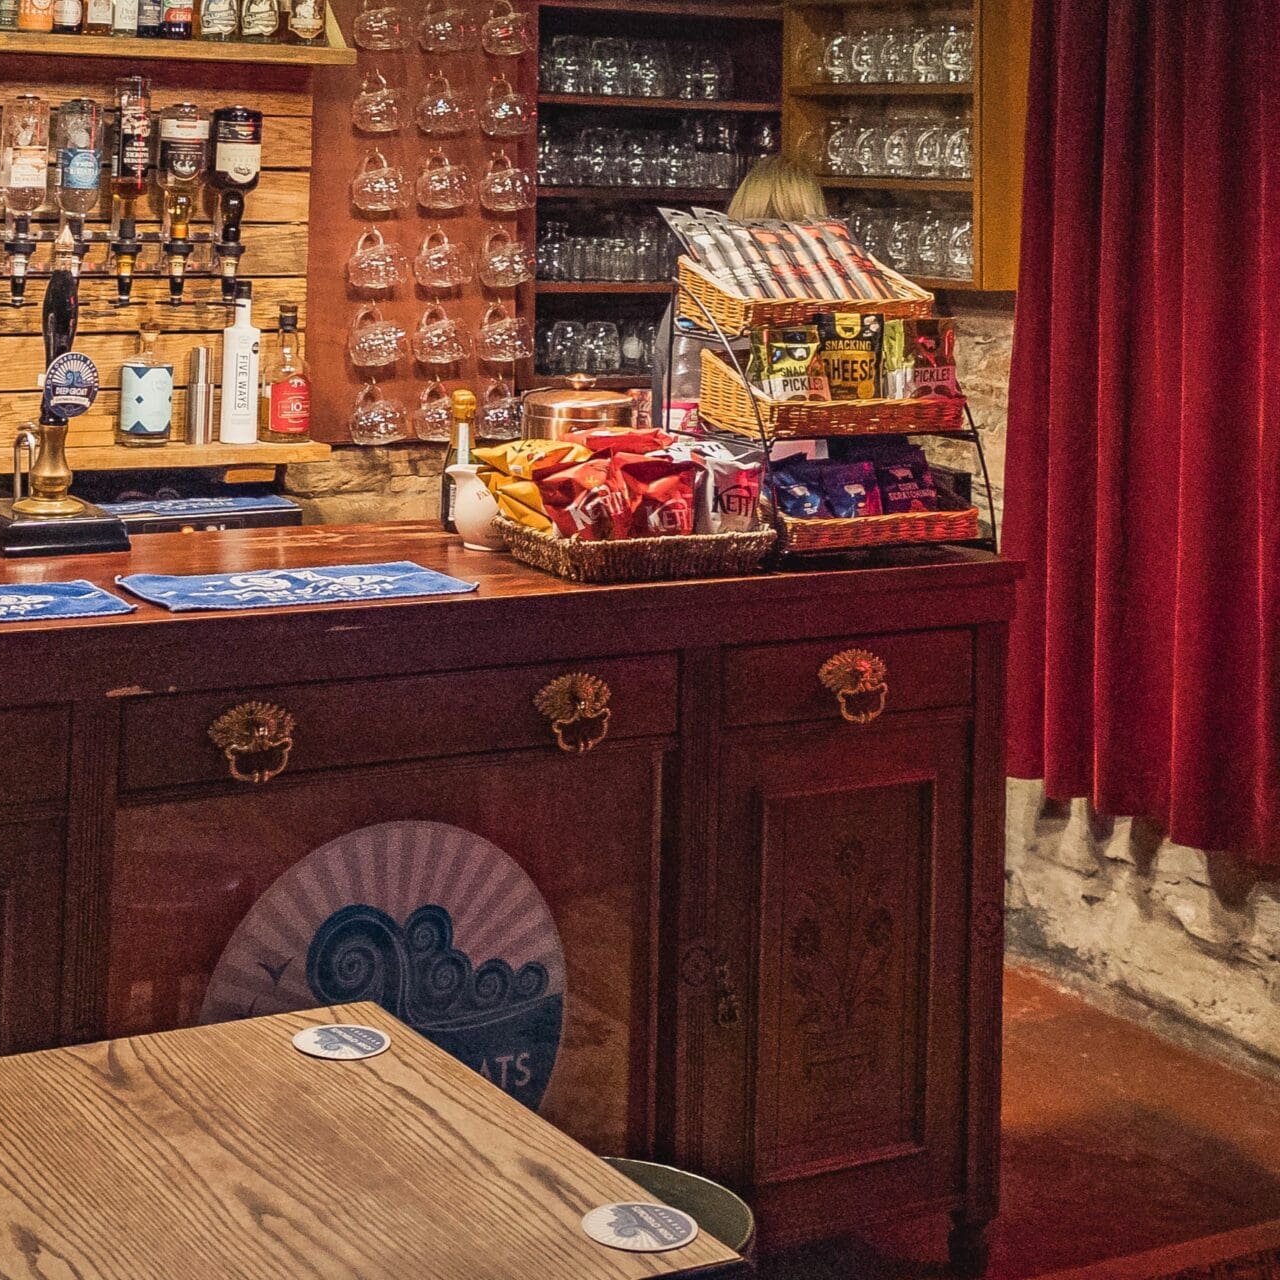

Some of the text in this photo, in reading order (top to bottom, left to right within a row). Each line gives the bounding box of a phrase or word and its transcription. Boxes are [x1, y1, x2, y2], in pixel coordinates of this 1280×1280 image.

[825, 339, 872, 352] SNACKING
[239, 355, 249, 377] FIVE
[823, 358, 876, 382] CHEESE
[782, 376, 824, 392] PICKLES
[237, 381, 248, 410] WAYS
[290, 401, 303, 412] 10
